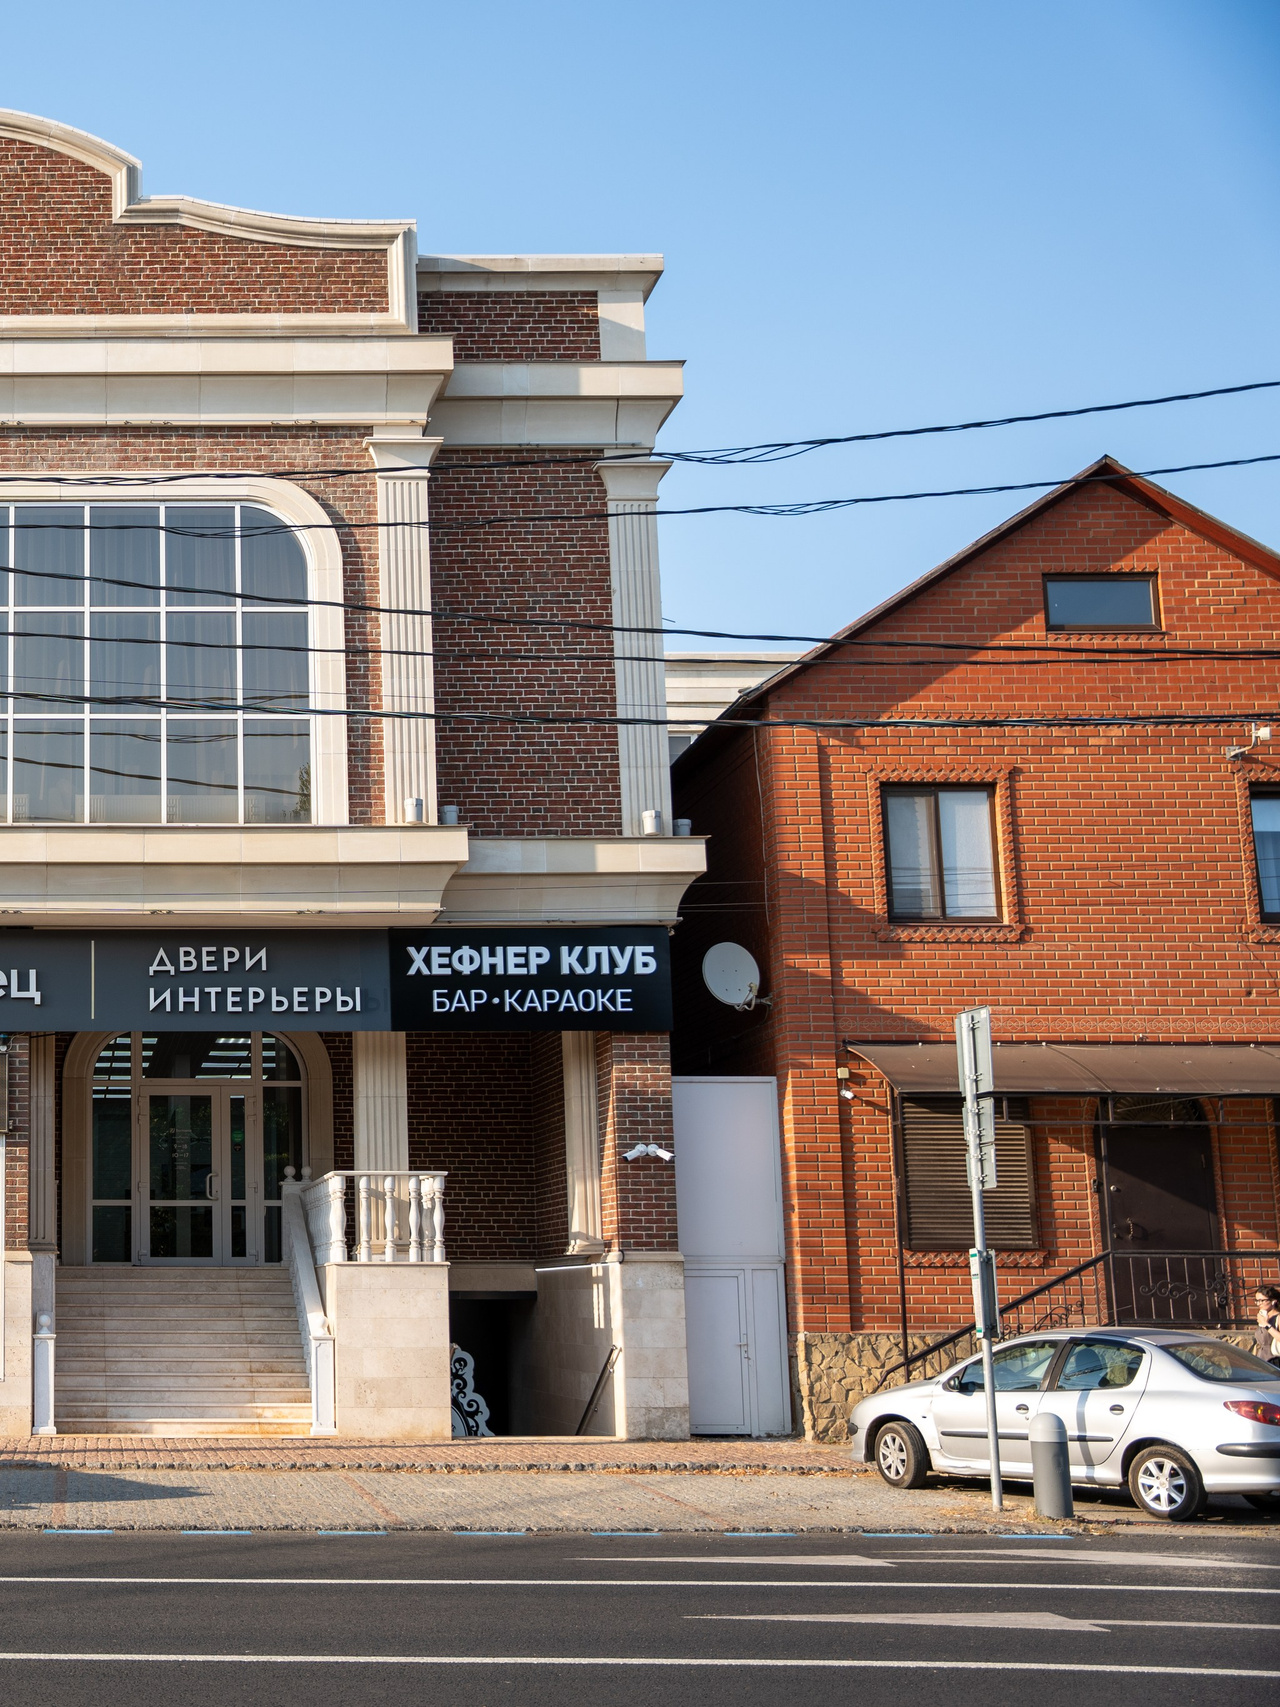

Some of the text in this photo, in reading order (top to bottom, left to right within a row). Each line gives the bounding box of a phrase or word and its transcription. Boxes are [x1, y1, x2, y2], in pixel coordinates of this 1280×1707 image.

[149, 947, 267, 975] ДВЕРИ
[407, 945, 657, 976] ХЕФНЕР КЛУБ
[149, 987, 361, 1012] ИНТЕРЬЕРЫ
